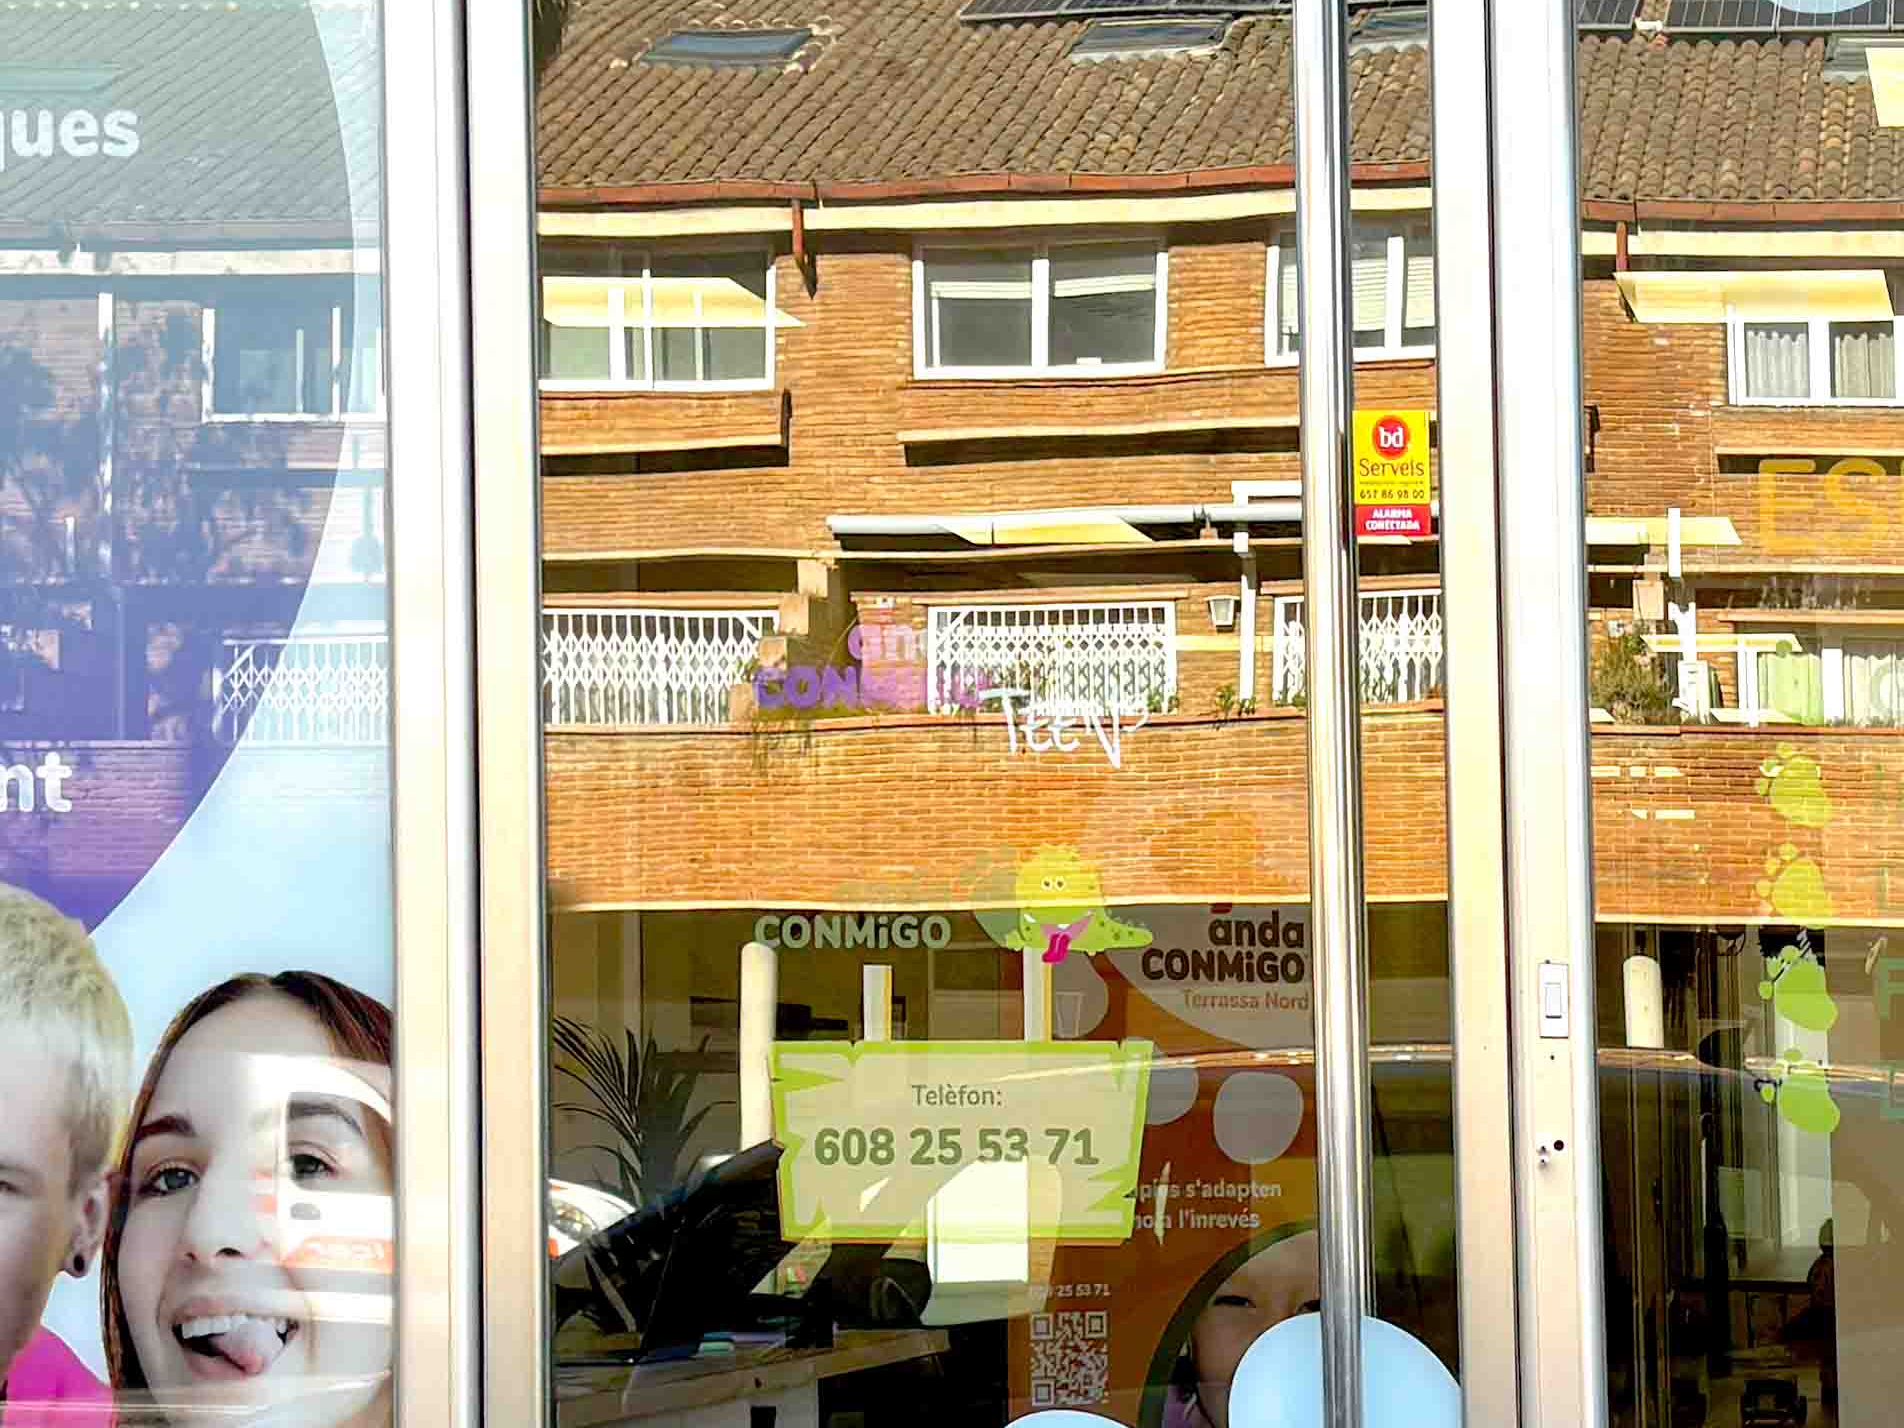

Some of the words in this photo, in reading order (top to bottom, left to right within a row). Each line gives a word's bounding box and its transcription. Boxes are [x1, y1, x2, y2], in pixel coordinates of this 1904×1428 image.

[1359, 456, 1425, 477] Serveis
[1372, 508, 1412, 519] ALARMA
[1208, 909, 1304, 949] anda
[1265, 990, 1310, 1012] Nord
[911, 1082, 1002, 1109] Telèfon:
[814, 1126, 895, 1167] 608
[909, 1126, 962, 1167] 25
[978, 1126, 1029, 1164] 53
[1045, 1126, 1100, 1167] 71
